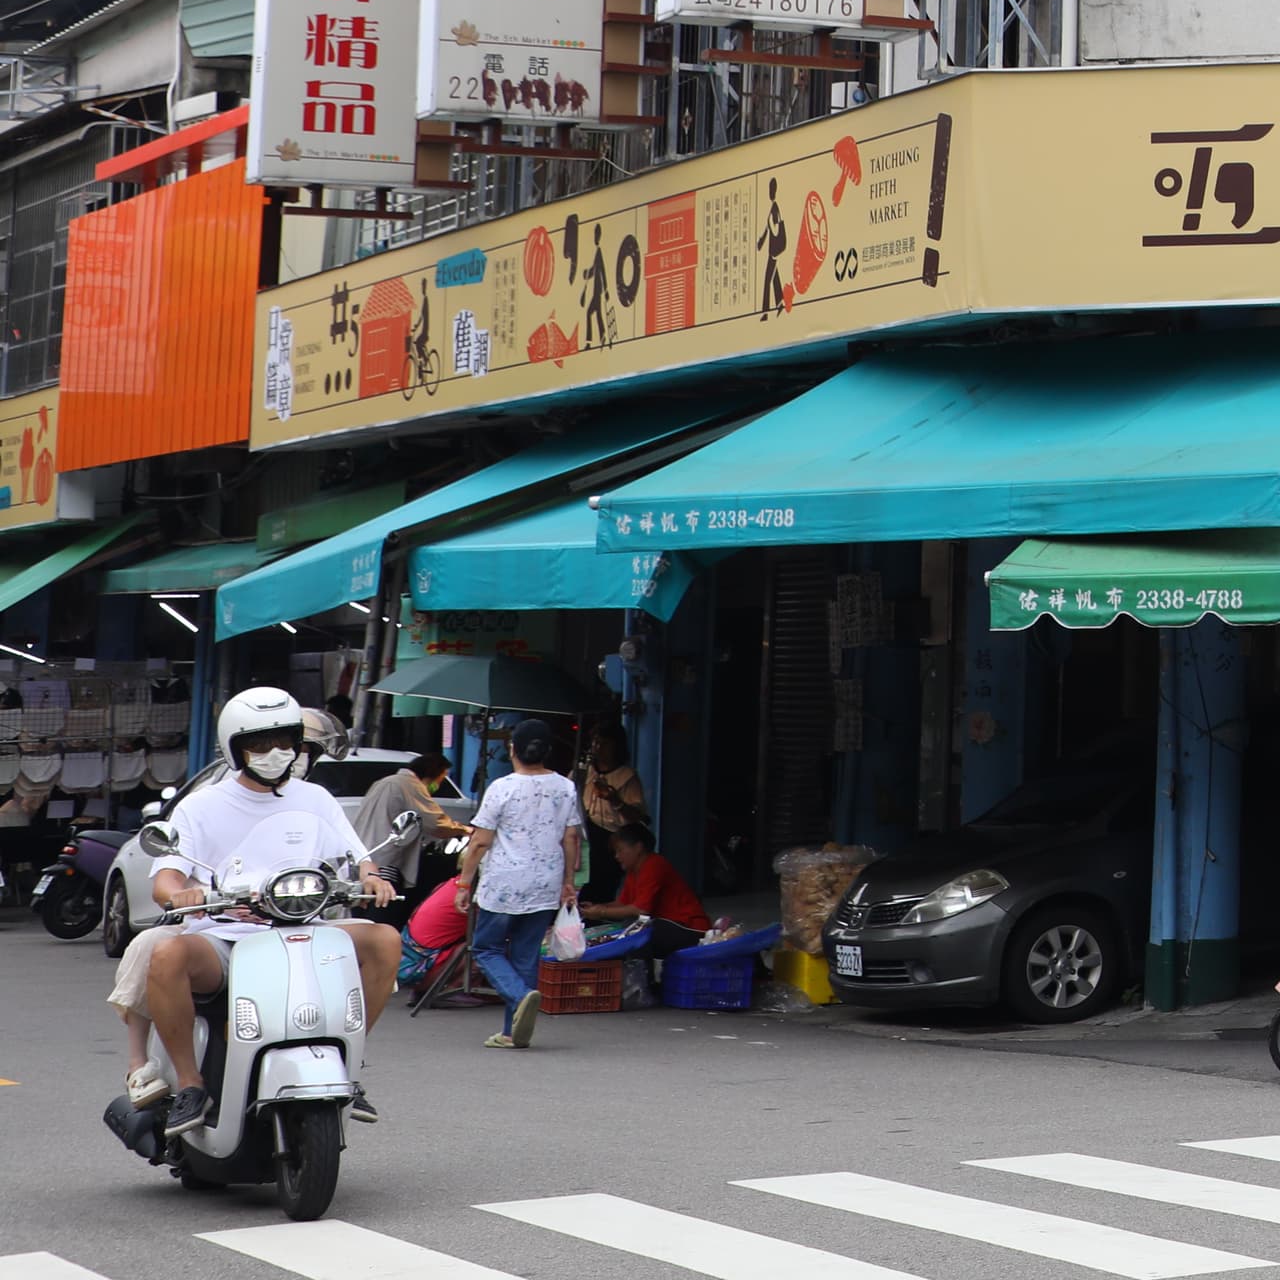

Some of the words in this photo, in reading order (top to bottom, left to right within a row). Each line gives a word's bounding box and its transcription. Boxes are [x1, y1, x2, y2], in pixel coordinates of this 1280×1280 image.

[484, 53, 550, 77] 電話
[870, 146, 920, 174] TAICHUNG
[870, 178, 897, 200] FIFTH
[869, 201, 909, 225] MARKET
[708, 508, 795, 529] 2338-4788
[1136, 589, 1243, 610] 2338-4788
